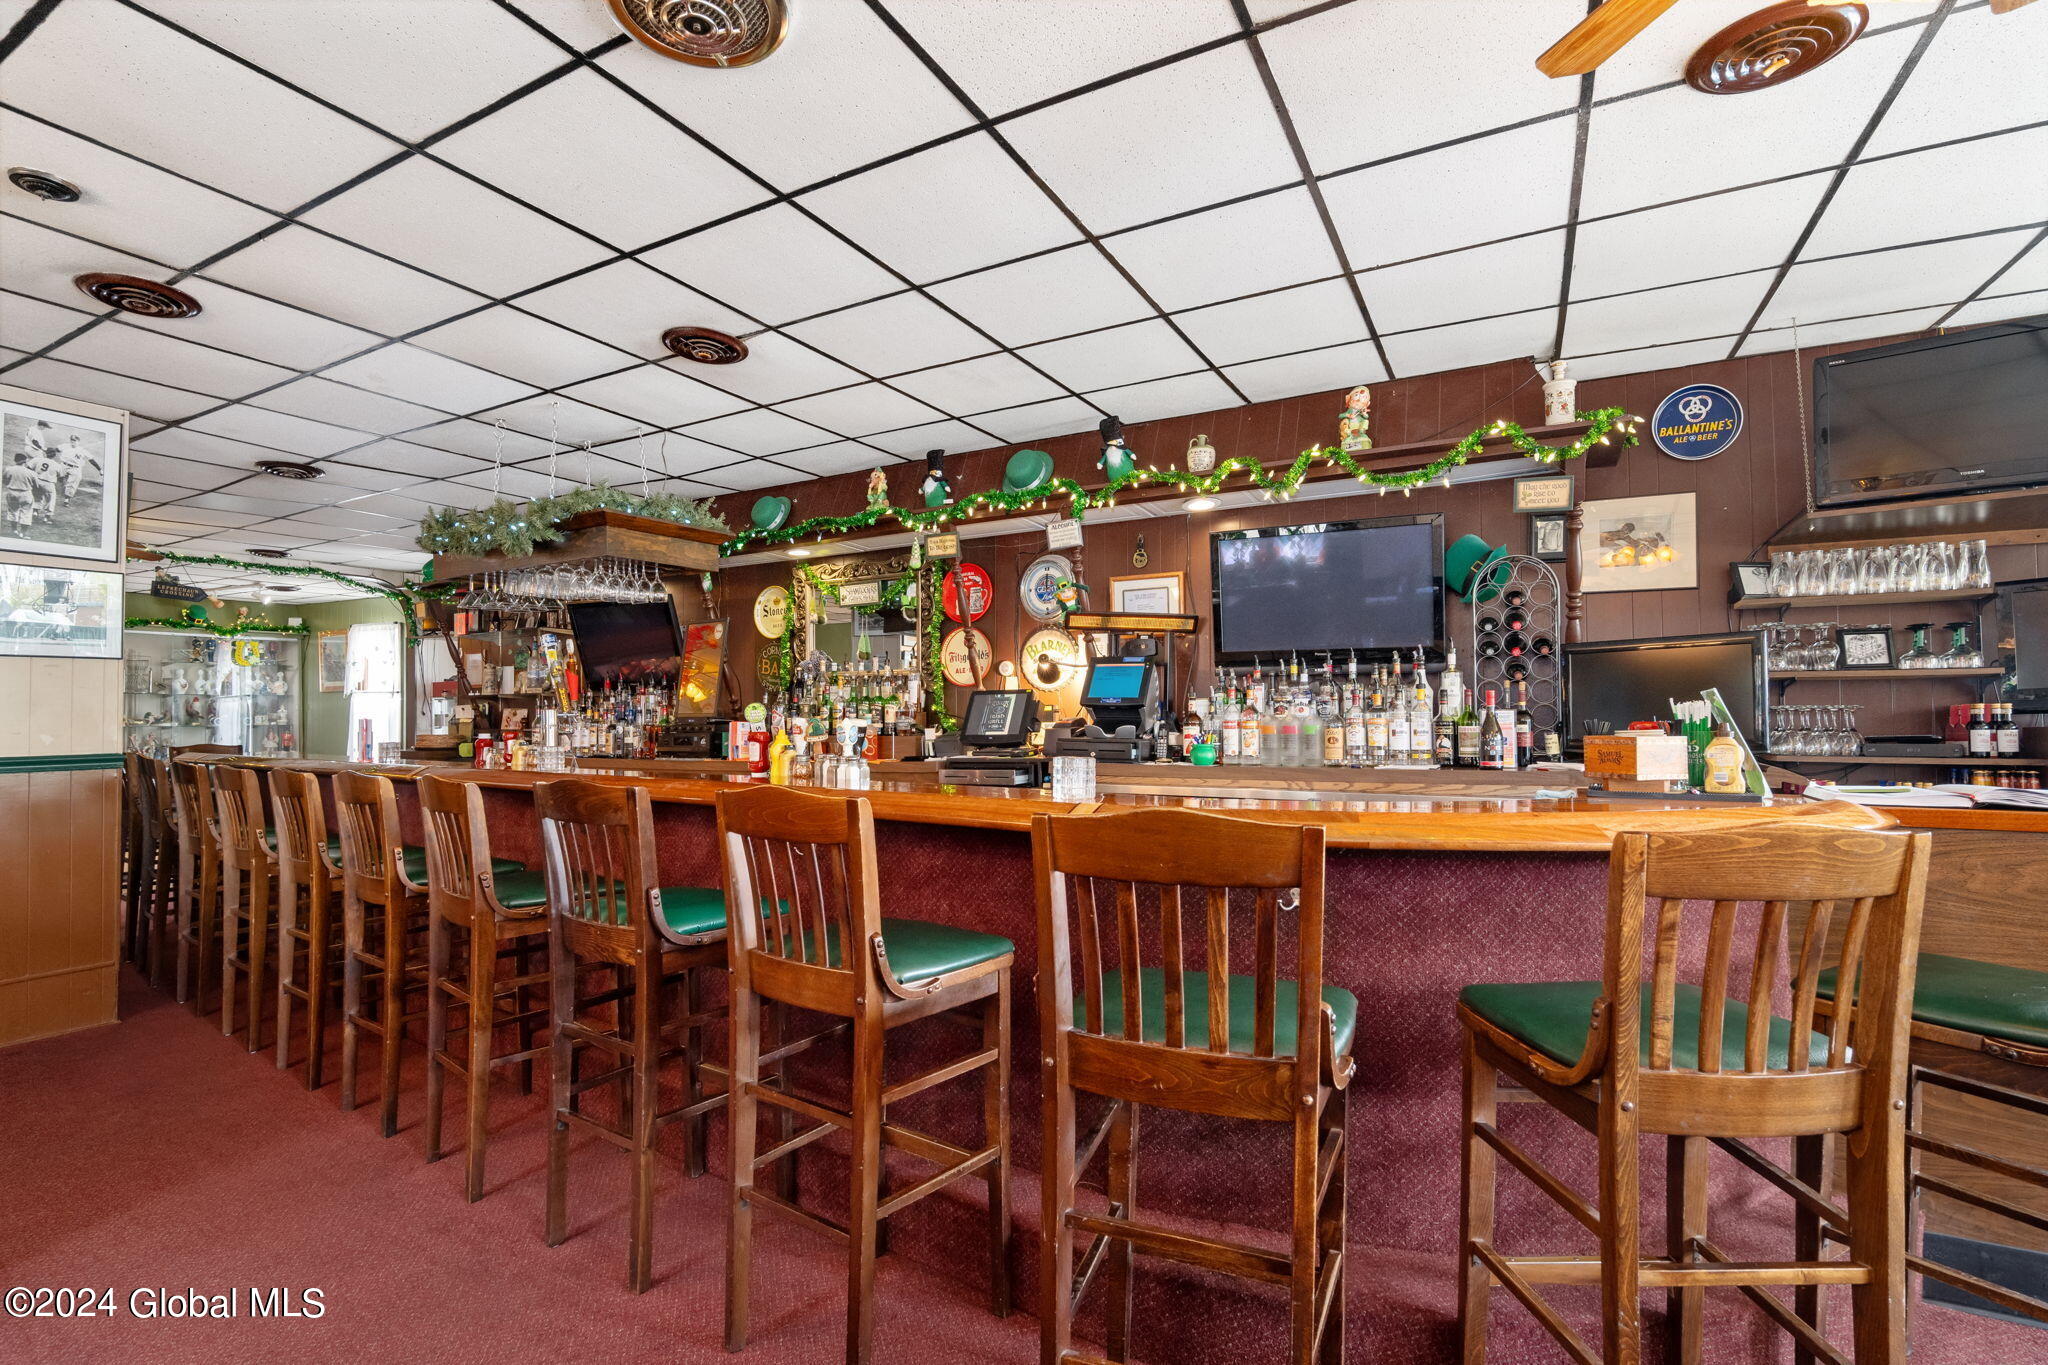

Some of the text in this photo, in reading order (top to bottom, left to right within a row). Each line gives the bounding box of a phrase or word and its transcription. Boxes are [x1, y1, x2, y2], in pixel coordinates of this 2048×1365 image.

[1659, 418, 1734, 437] BALLANTINE'S
[1673, 432, 1719, 444] ALE BEER
[41, 462, 50, 472] 9
[157, 584, 199, 594] LEPRECHAUN
[160, 589, 194, 598] CROSSING
[1026, 639, 1071, 660] BLARNEY
